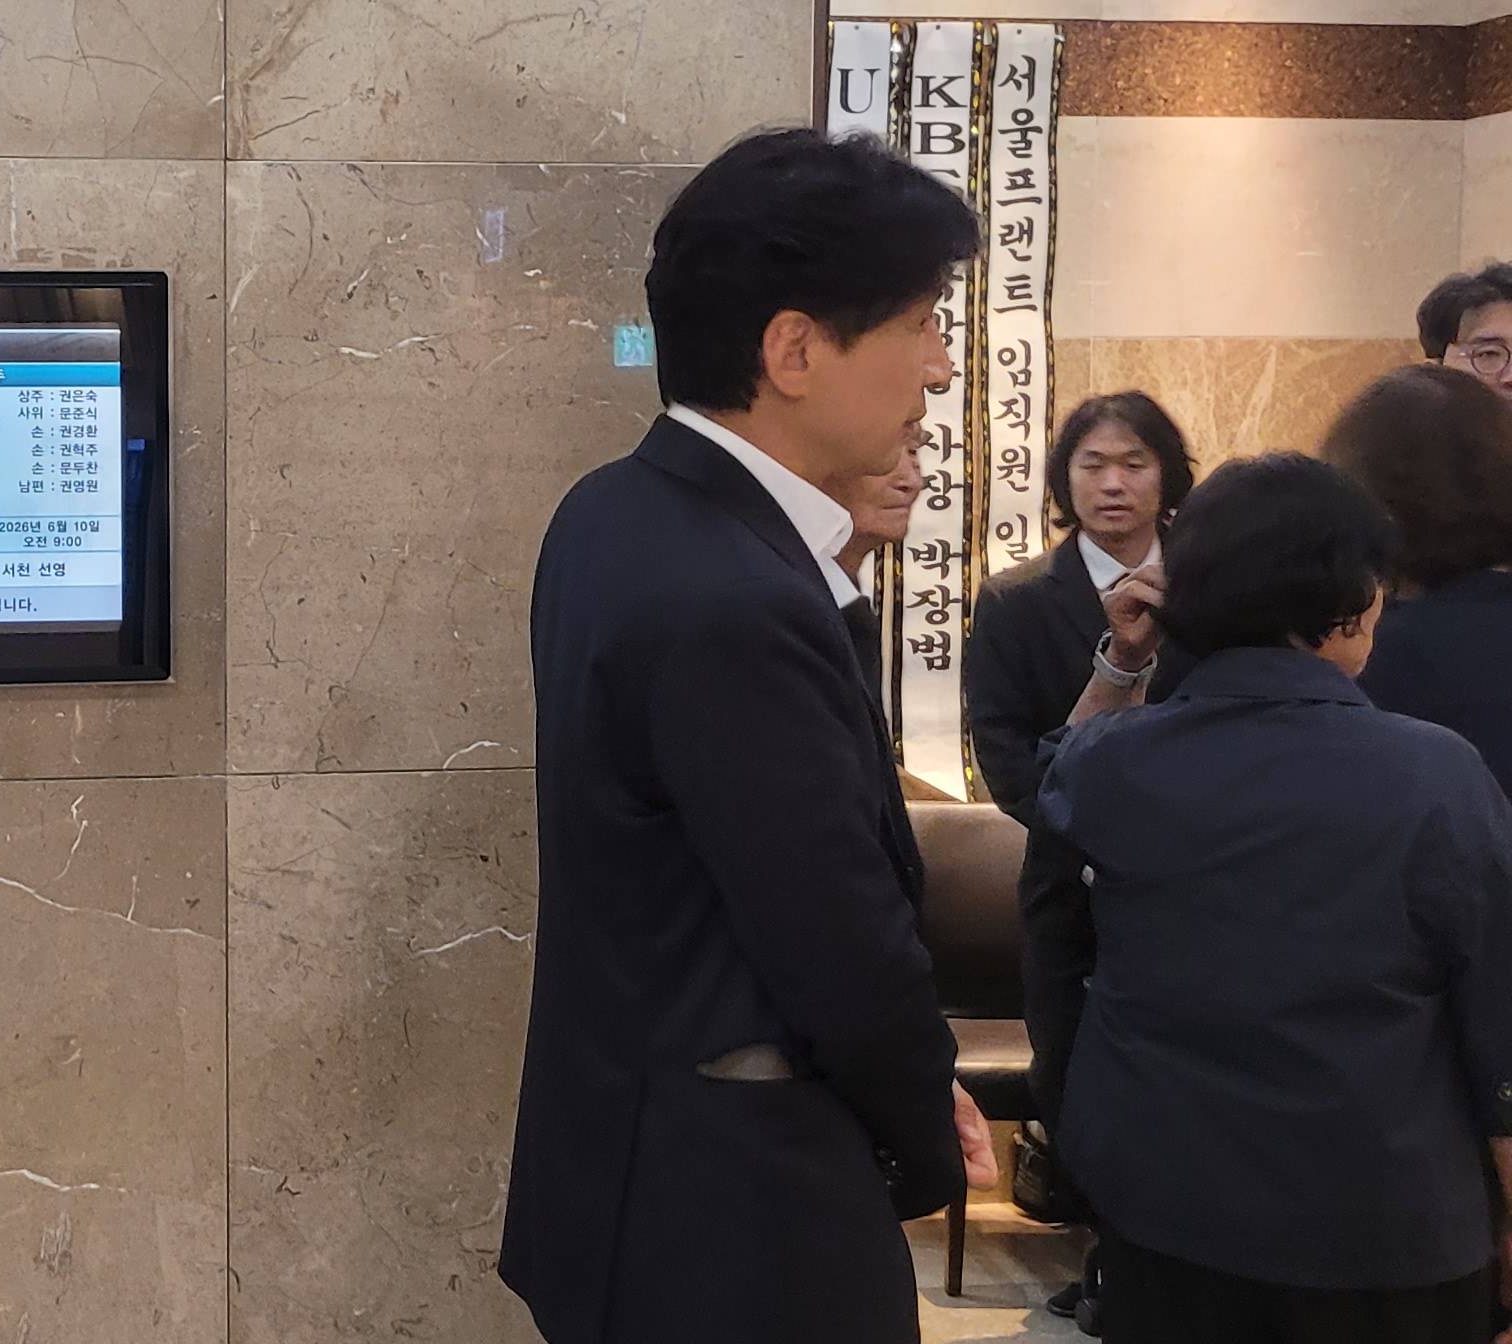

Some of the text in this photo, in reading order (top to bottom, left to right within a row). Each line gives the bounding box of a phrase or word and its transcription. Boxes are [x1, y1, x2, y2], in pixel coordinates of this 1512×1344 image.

[837, 68, 881, 114] U
[914, 75, 968, 180] KB
[993, 55, 1043, 314] 서울프랜트
[18, 390, 44, 403] 상주
[59, 390, 98, 403] 권은숙
[18, 407, 44, 420] 사위
[59, 407, 98, 421] 문준식
[994, 339, 1032, 492] 임직원
[31, 426, 44, 438] 손
[31, 444, 44, 457] 손
[31, 462, 44, 475] 손
[18, 480, 44, 493] 남편
[59, 480, 98, 493] 권영원
[47, 521, 67, 533] 6월
[74, 521, 100, 533] 10일
[23, 536, 82, 548] 오전 9:00
[2, 563, 30, 577] 서천
[38, 562, 66, 577] 선영
[906, 539, 963, 671] 박장범
